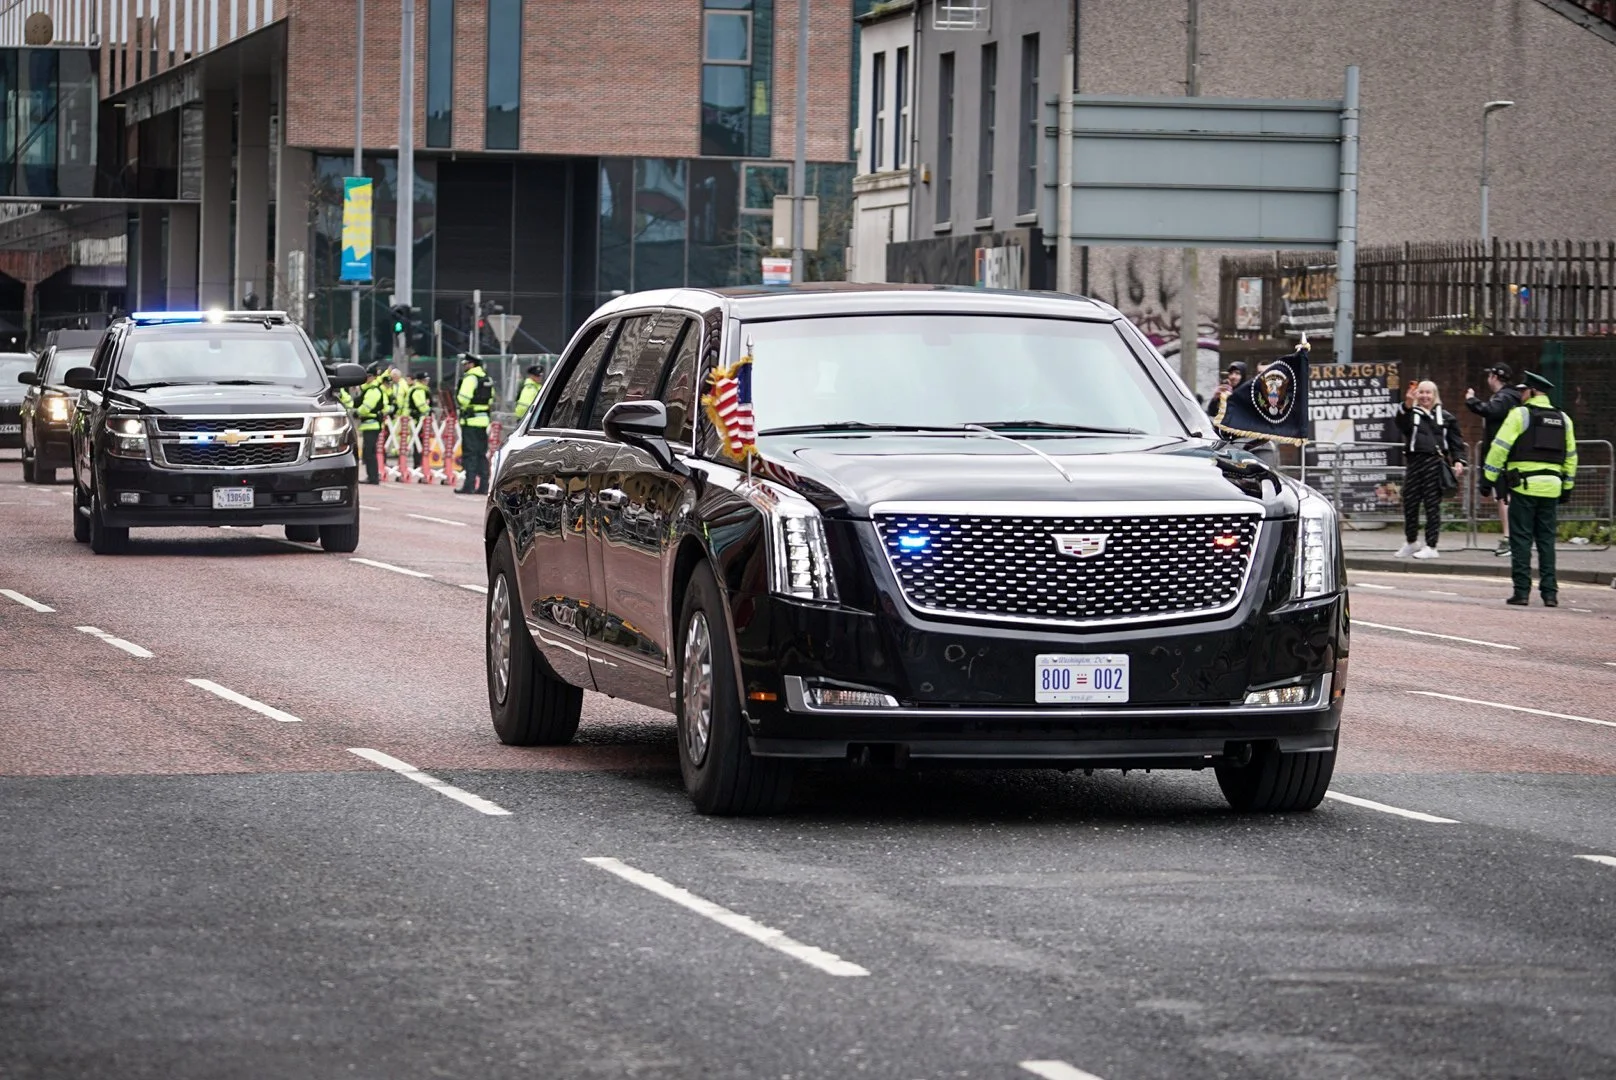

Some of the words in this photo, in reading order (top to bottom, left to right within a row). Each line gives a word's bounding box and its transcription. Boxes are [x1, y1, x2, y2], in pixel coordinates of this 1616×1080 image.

[1311, 378, 1366, 388] LOUNGE
[1370, 378, 1381, 387] &
[1308, 389, 1360, 398] SPORTS
[1363, 388, 1390, 396] BAR
[1348, 403, 1399, 419] OPEN
[1042, 668, 1070, 690] 800
[1094, 668, 1123, 690] 002
